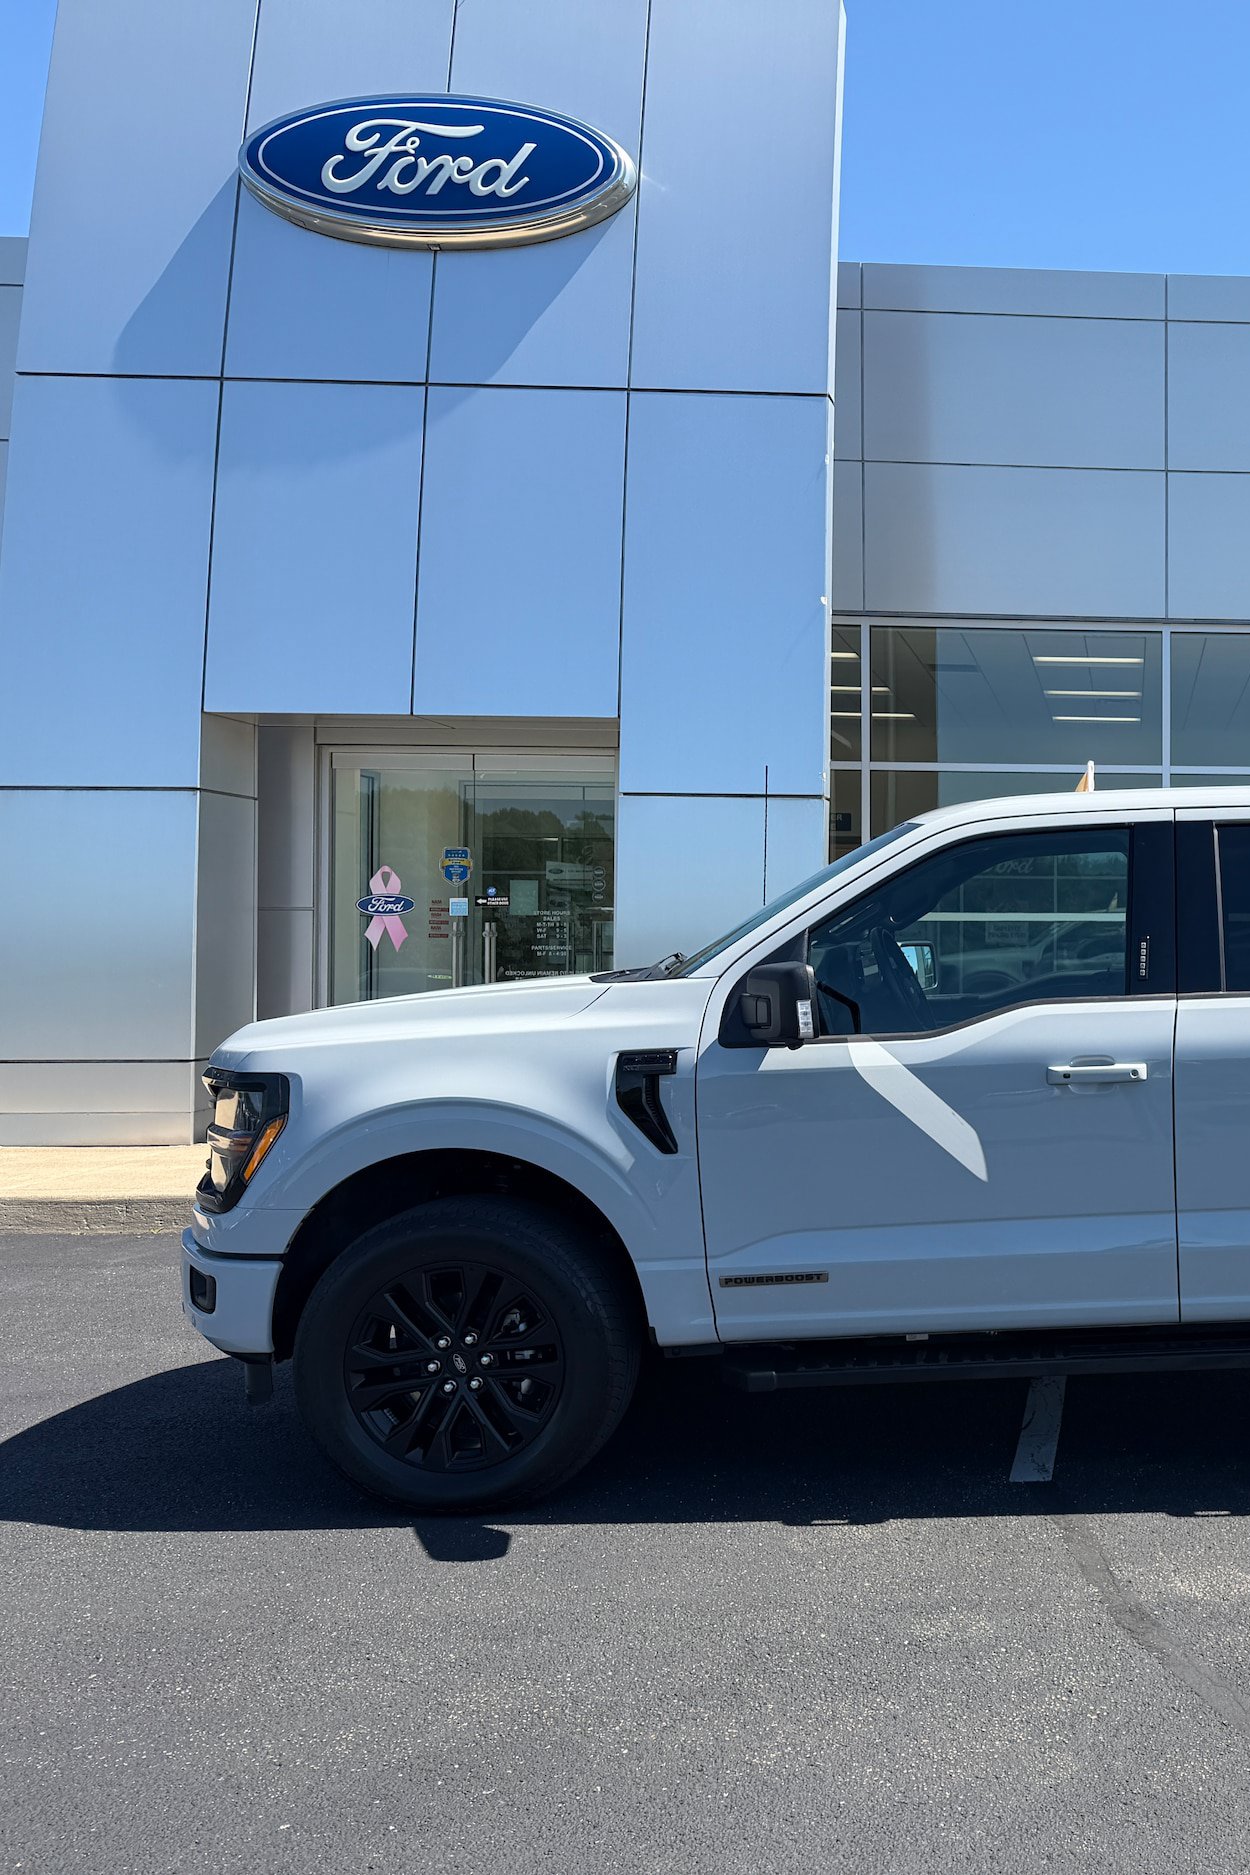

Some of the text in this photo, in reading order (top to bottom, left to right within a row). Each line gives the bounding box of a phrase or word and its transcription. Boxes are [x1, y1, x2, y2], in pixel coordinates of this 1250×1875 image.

[320, 117, 537, 199] Ford
[367, 896, 405, 912] Ford
[724, 1273, 823, 1285] POWERBOOST
